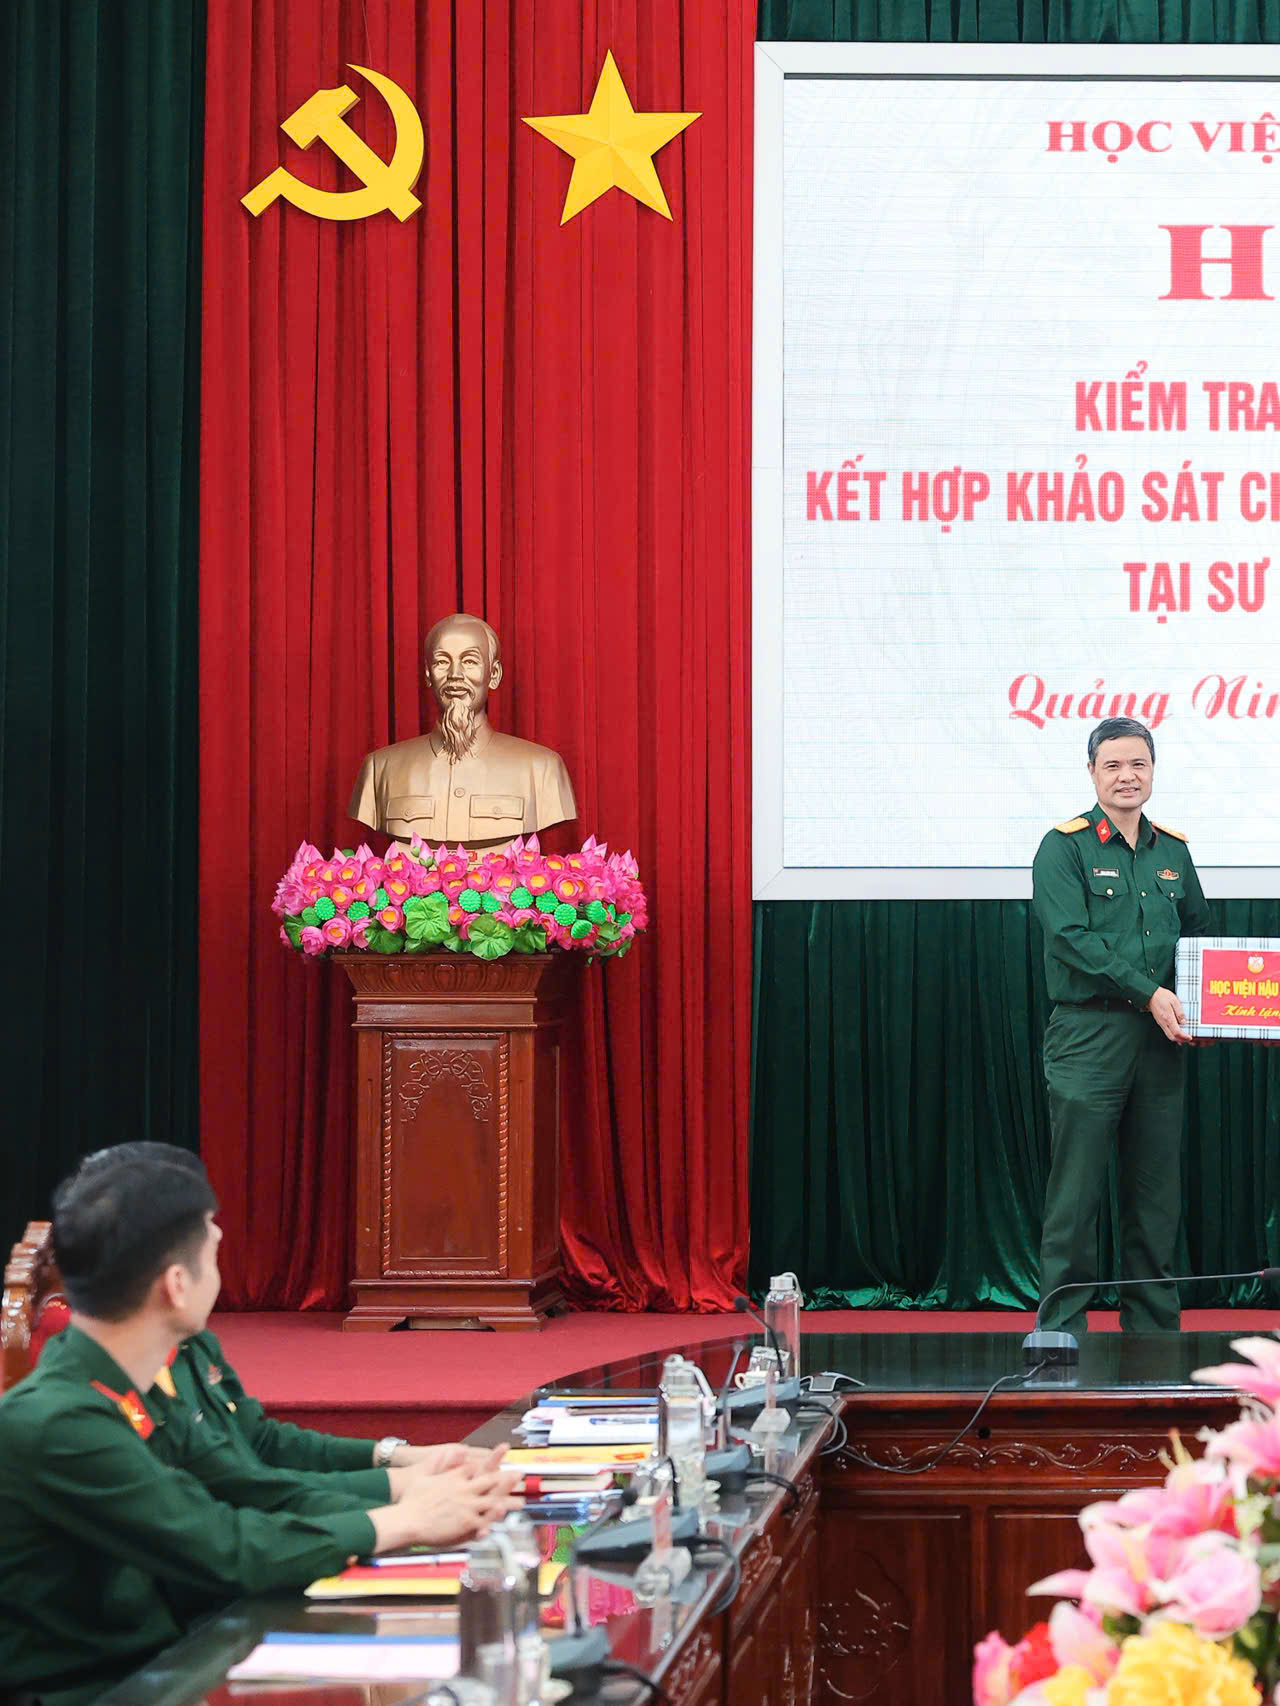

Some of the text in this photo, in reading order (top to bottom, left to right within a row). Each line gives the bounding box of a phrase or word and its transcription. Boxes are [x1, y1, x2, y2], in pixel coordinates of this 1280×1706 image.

[1048, 121, 1171, 162] HỌC
[1076, 360, 1187, 432] KIỂM
[807, 454, 886, 521] KẾT
[903, 466, 990, 533] HỢP
[1008, 454, 1124, 522] KHẢO
[1142, 460, 1224, 522] SÁT
[1123, 562, 1190, 623] TẠI
[1208, 557, 1270, 612] SƯ
[1009, 673, 1170, 729] Quảng
[1209, 980, 1231, 998] HỌC
[1233, 978, 1256, 999] VIỆN
[1258, 979, 1279, 999] HẬU
